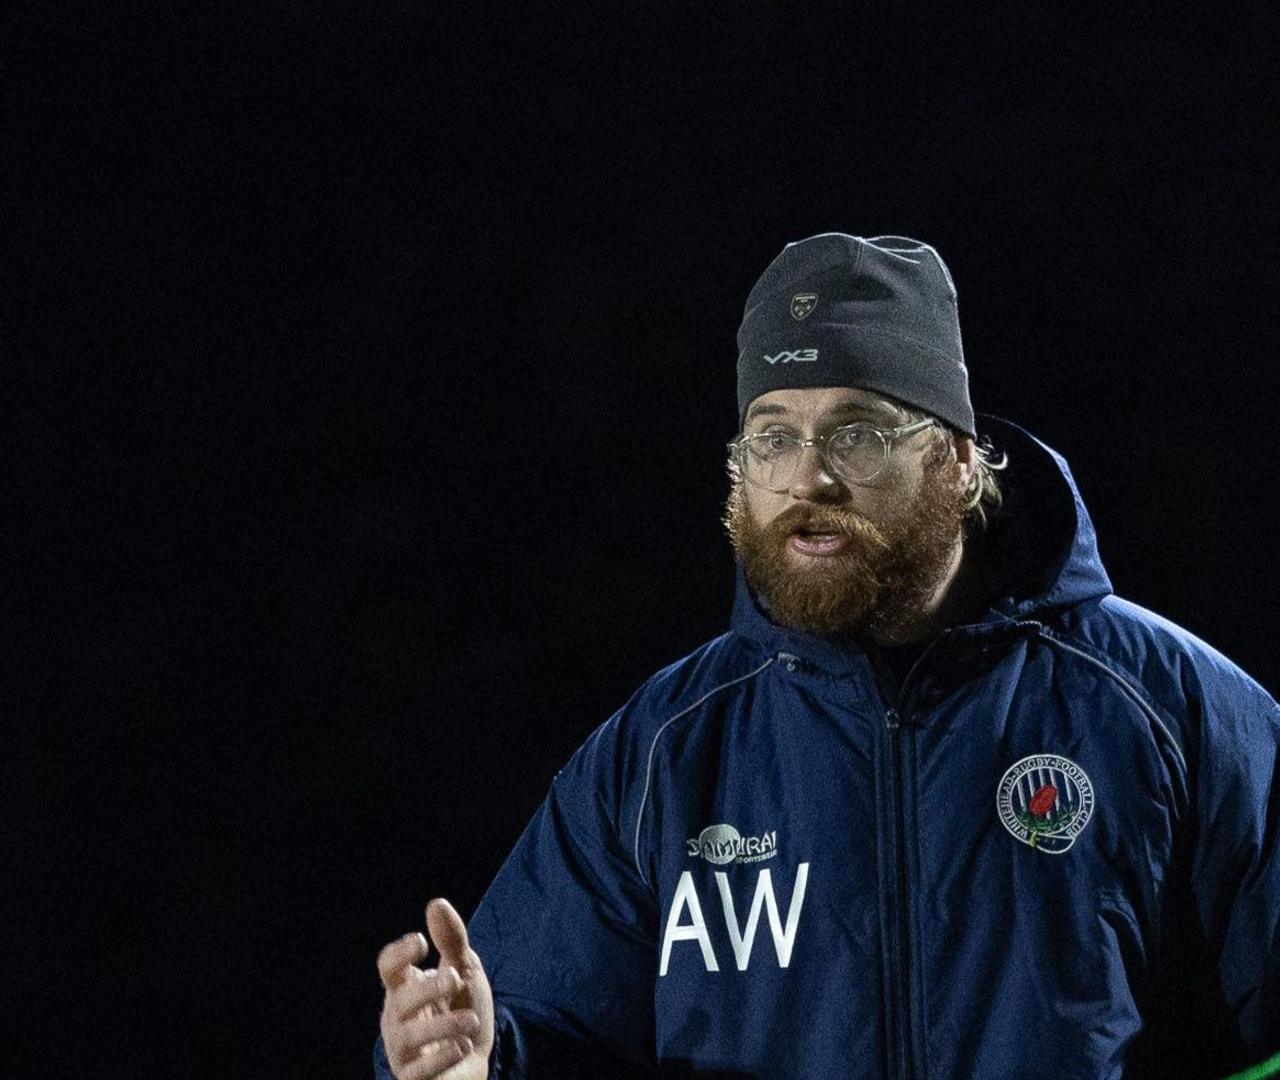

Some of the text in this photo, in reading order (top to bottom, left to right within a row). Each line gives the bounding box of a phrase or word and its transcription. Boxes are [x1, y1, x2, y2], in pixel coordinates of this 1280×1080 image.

[763, 348, 818, 365] VX3
[1015, 758, 1051, 777] RUGBY
[1055, 759, 1092, 806] FOOTBALL
[1066, 809, 1089, 838] CLUB
[686, 830, 777, 858] SAMURAI
[659, 862, 810, 977] AW
